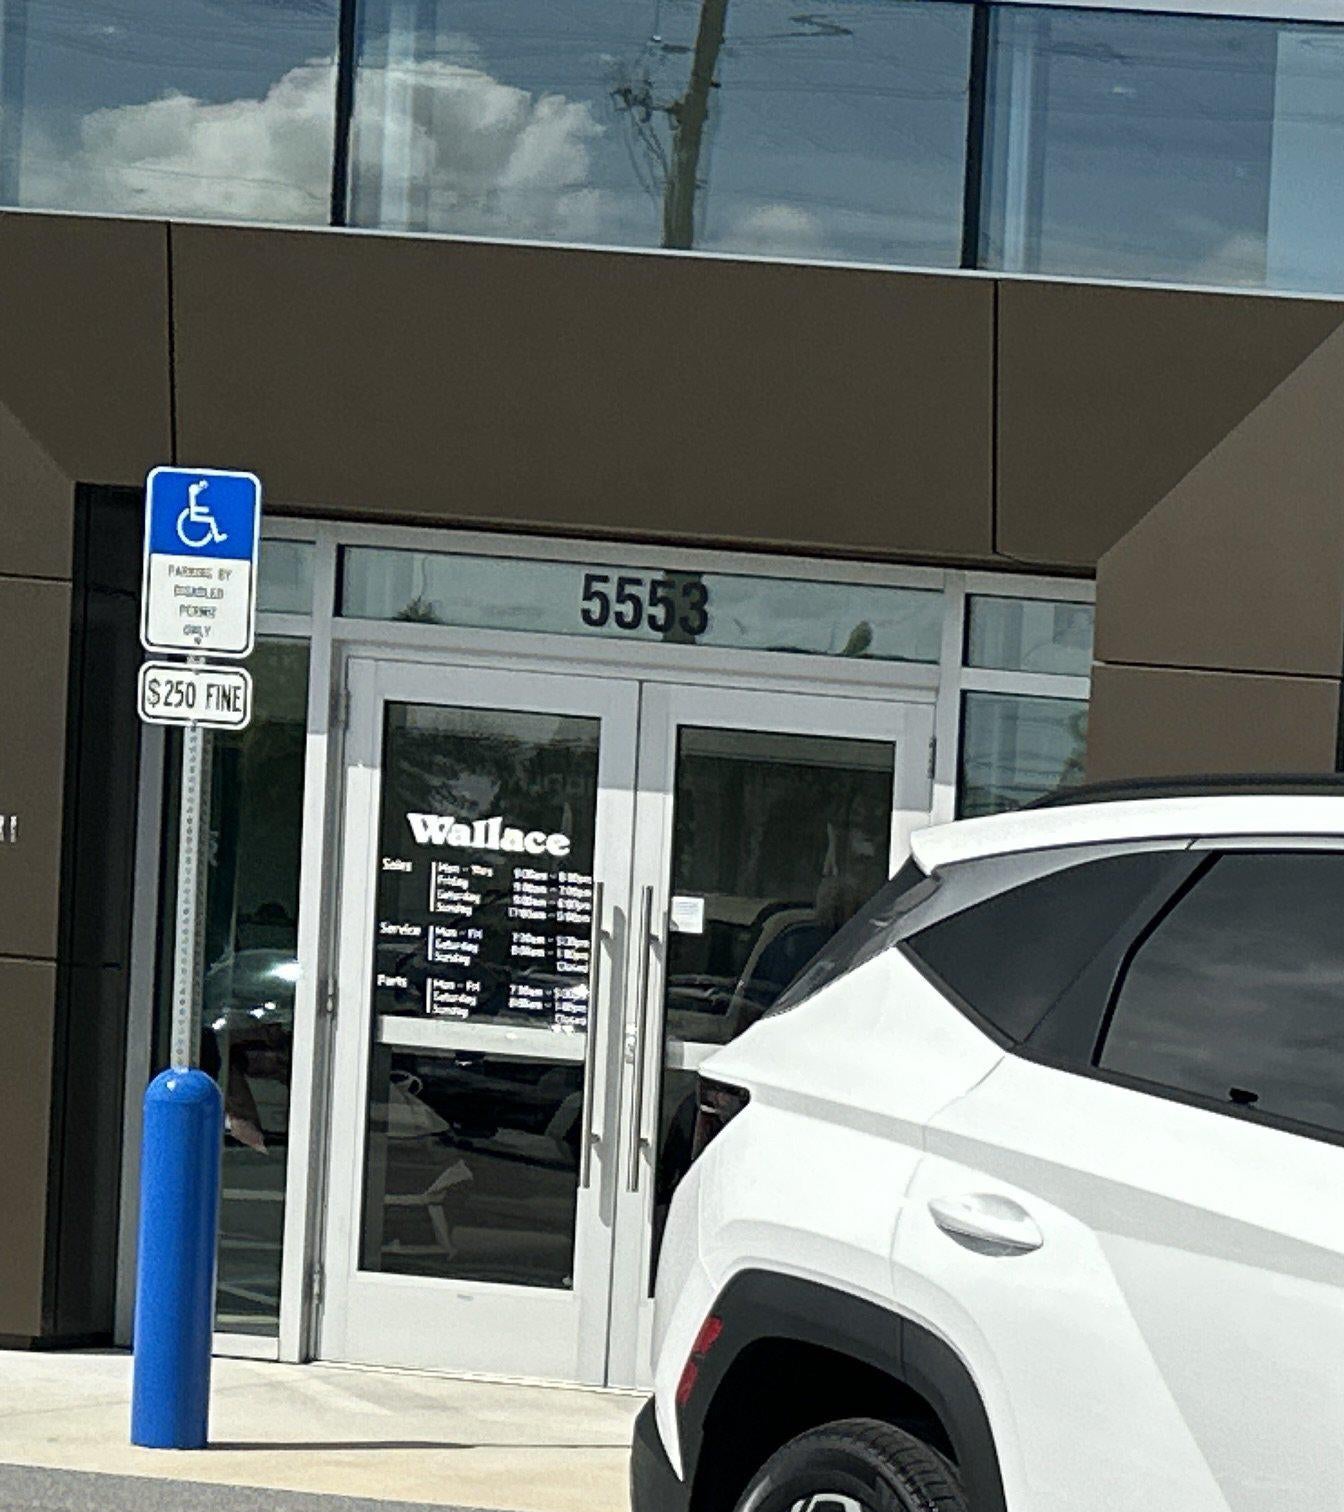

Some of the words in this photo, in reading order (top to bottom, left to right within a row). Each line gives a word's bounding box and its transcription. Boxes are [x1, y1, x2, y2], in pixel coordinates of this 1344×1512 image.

[218, 567, 232, 580] BY
[580, 573, 709, 636] 5553
[147, 678, 196, 709] $250
[205, 683, 242, 712] FINE
[406, 812, 571, 857] Wallace
